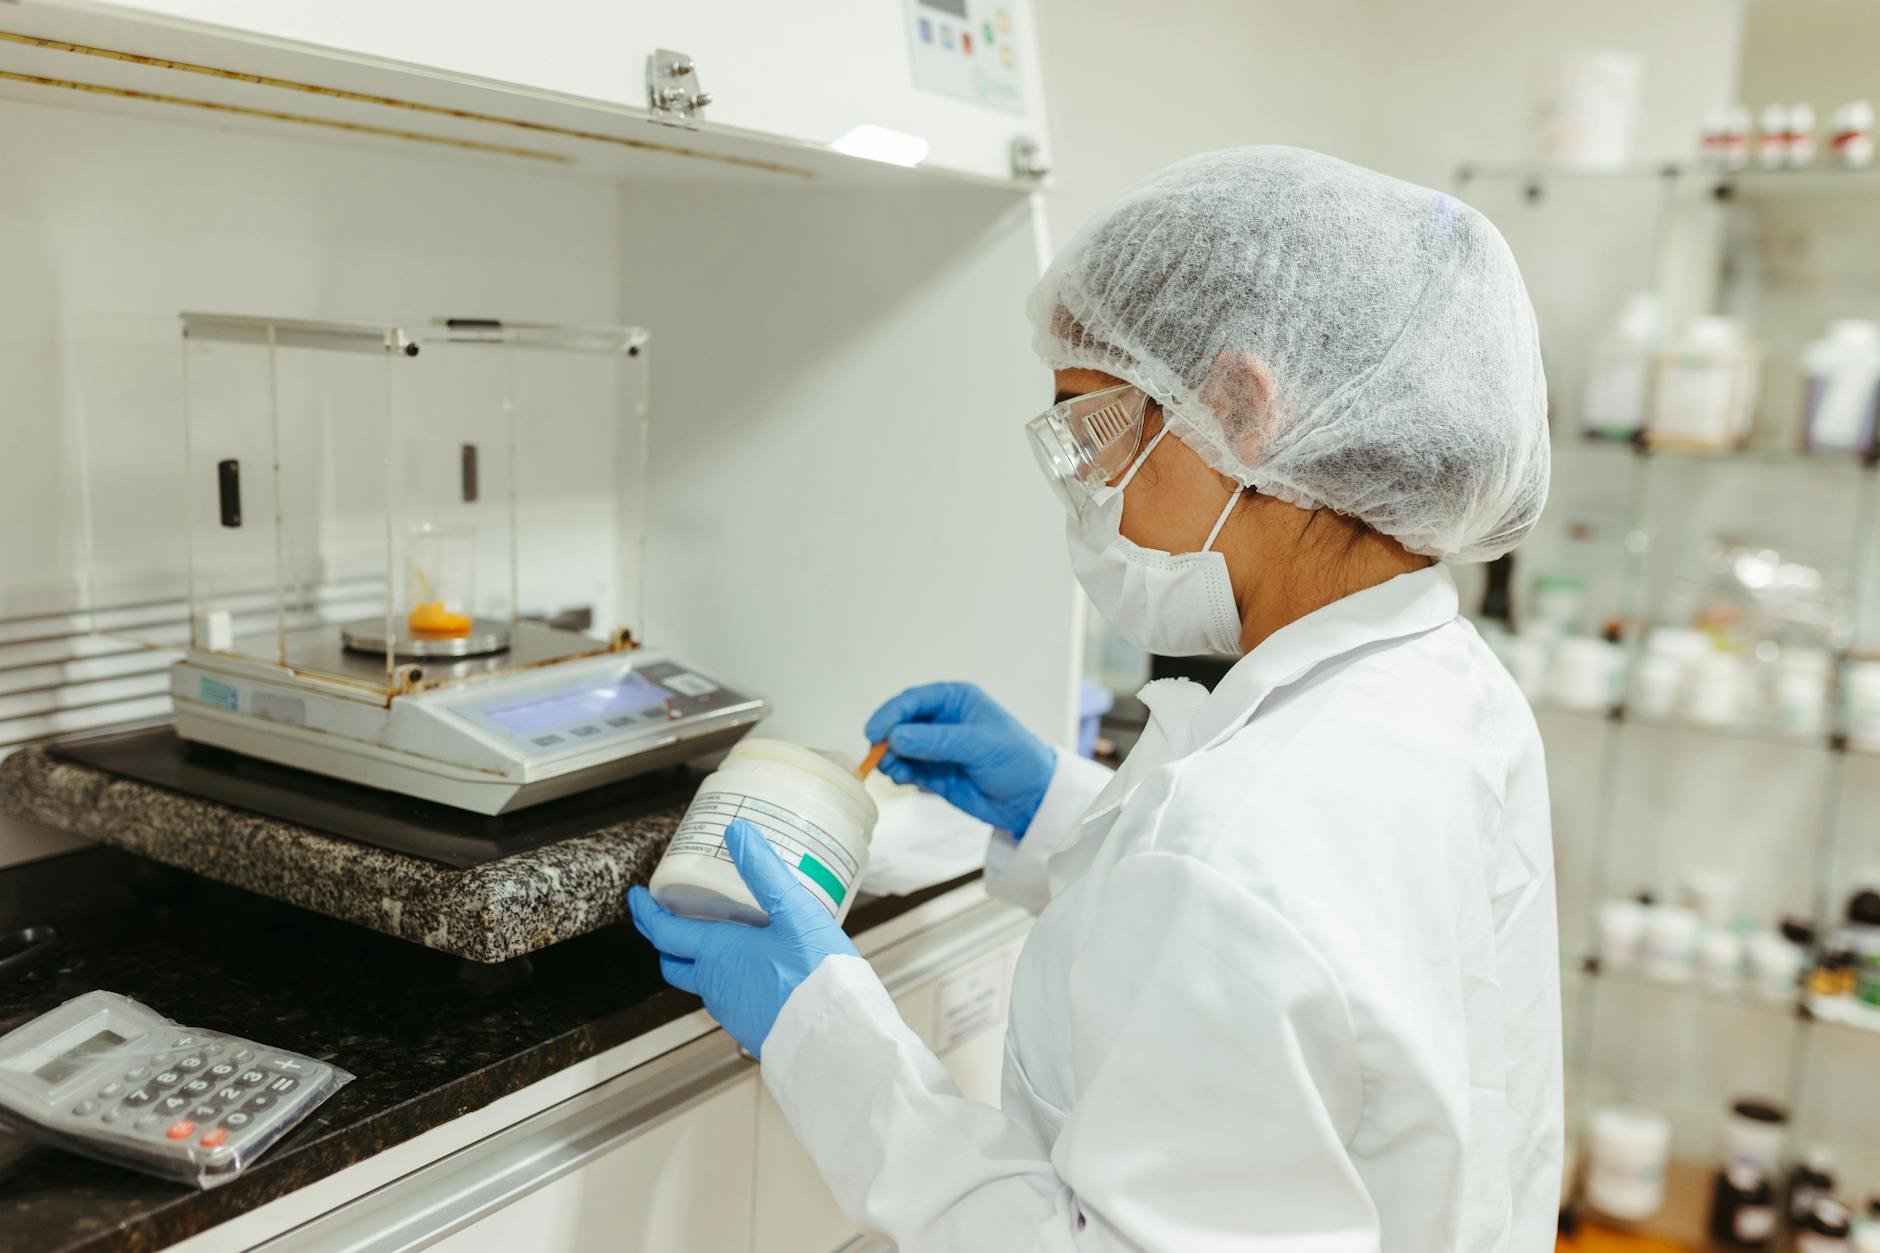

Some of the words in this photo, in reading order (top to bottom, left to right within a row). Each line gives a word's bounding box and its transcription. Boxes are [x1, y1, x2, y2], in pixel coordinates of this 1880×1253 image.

[181, 1057, 201, 1067] 9
[212, 1064, 232, 1074] 6
[157, 1072, 177, 1083] 8
[243, 1071, 263, 1082] 3
[188, 1079, 208, 1091] 5
[130, 1090, 149, 1101] 7
[220, 1088, 240, 1099] 2
[167, 1097, 185, 1108] 4
[197, 1106, 215, 1116] 1
[228, 1112, 247, 1124] 0
